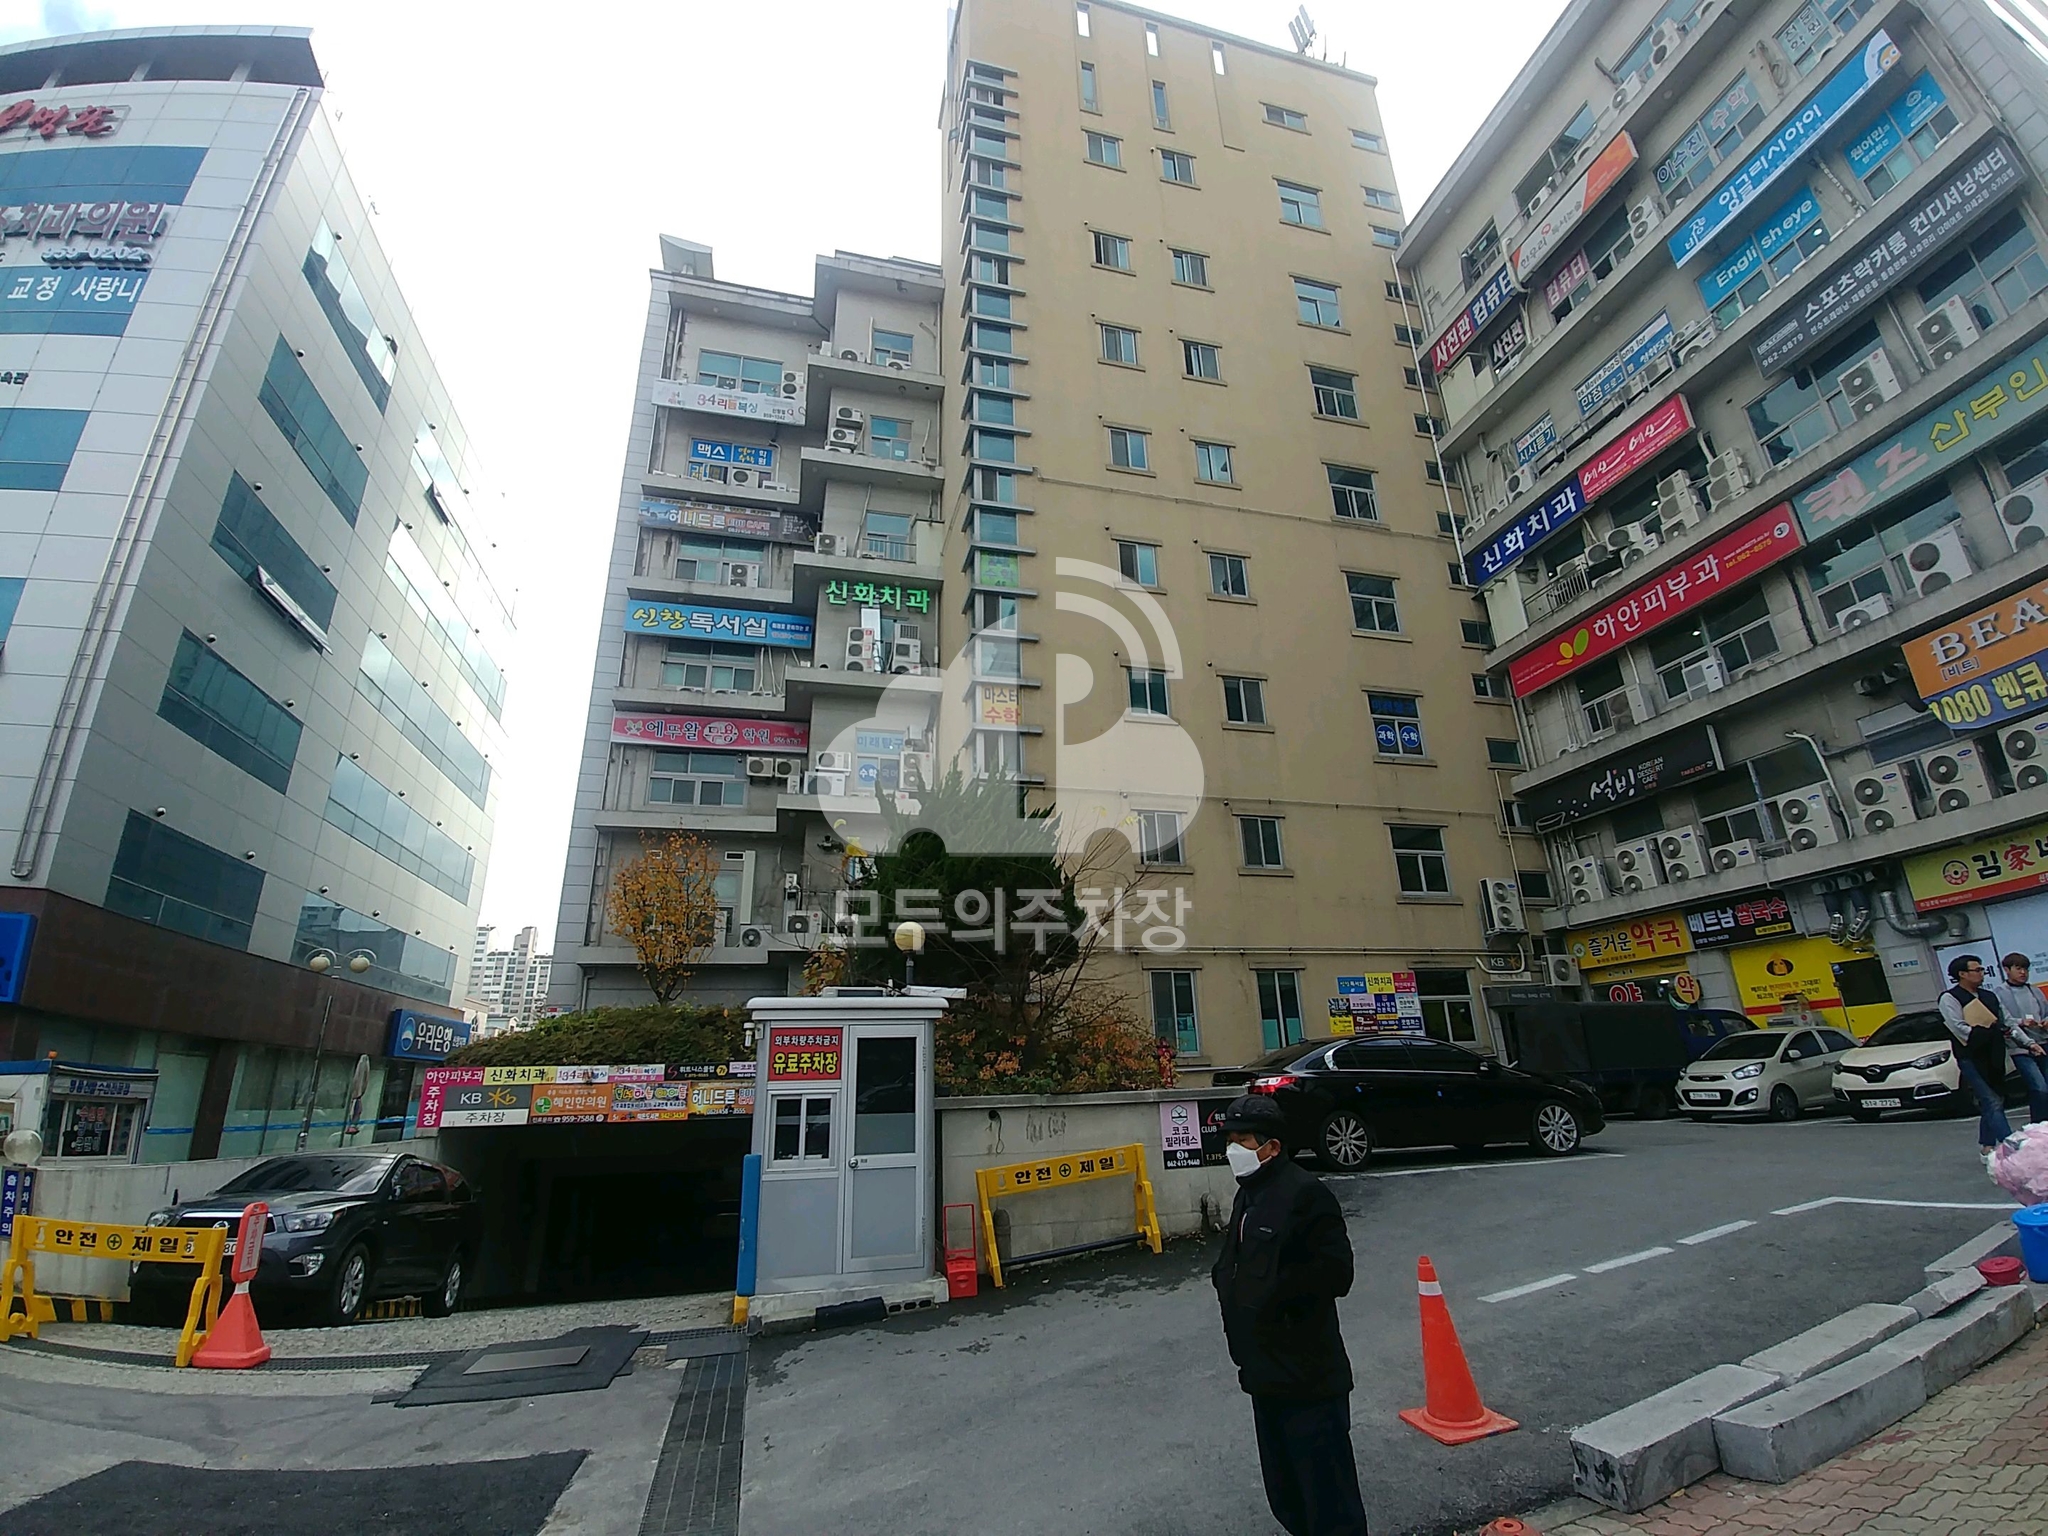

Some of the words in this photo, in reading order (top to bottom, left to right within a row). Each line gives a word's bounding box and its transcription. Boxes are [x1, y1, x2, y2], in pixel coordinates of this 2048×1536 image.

[1656, 132, 1708, 184] 이수진
[1711, 87, 1750, 131] 수학
[1718, 103, 1822, 213] 잉글리시아이
[1804, 231, 1908, 323] 스포츠락커룸
[1909, 146, 2008, 238] 컨디셔닝센터
[8, 276, 61, 299] 교정
[71, 277, 142, 302] 사랑니
[1545, 253, 1588, 306] 컴퓨터
[1434, 315, 1472, 367] 사진관
[1471, 269, 1514, 326] 컴퓨터
[1493, 318, 1523, 363] 사진관
[697, 443, 725, 460] 맥스
[1519, 429, 1556, 463] 시사듣기
[669, 509, 725, 529] 허니드론
[1482, 486, 1577, 573] 신화치과
[824, 580, 930, 614] 신화치과
[1593, 554, 1719, 639] 하얀피부과
[689, 611, 768, 638] 독서실
[1929, 588, 2048, 667] BEA
[984, 706, 1020, 725] 수학
[743, 728, 770, 744] 학원
[1402, 731, 1418, 742] 수학
[1590, 768, 1636, 801] 설빙
[1971, 840, 2048, 880] 김家
[1687, 907, 1735, 933] 베트남
[1735, 897, 1788, 926] 쌀국수
[1588, 931, 1632, 957] 즐거운
[1630, 919, 1681, 953] 약국
[1490, 957, 1504, 968] KB
[1367, 976, 1393, 986] 신화치과
[1677, 975, 1696, 1000] 약
[415, 1022, 453, 1053] 우리은행
[774, 1035, 839, 1047] 외부차량주차금지
[490, 1068, 546, 1082] 신화치과
[773, 1052, 838, 1075] 유료주차장
[426, 1070, 484, 1084] 하얀피부과
[422, 1086, 441, 1126] 주차장
[460, 1093, 482, 1105] KB
[692, 1088, 736, 1106] 허니드론
[465, 1112, 506, 1124] 주차장
[561, 1115, 595, 1123] 959-7588
[1171, 1126, 1190, 1136] 코코
[1201, 1125, 1218, 1134] CLUB
[1165, 1136, 1198, 1148] 필라테스
[1014, 1167, 1051, 1185] 안전
[1079, 1155, 1115, 1175] 제일
[2, 1174, 17, 1235] 출차주의
[55, 1229, 97, 1248] 안전
[132, 1235, 179, 1254] 제일
